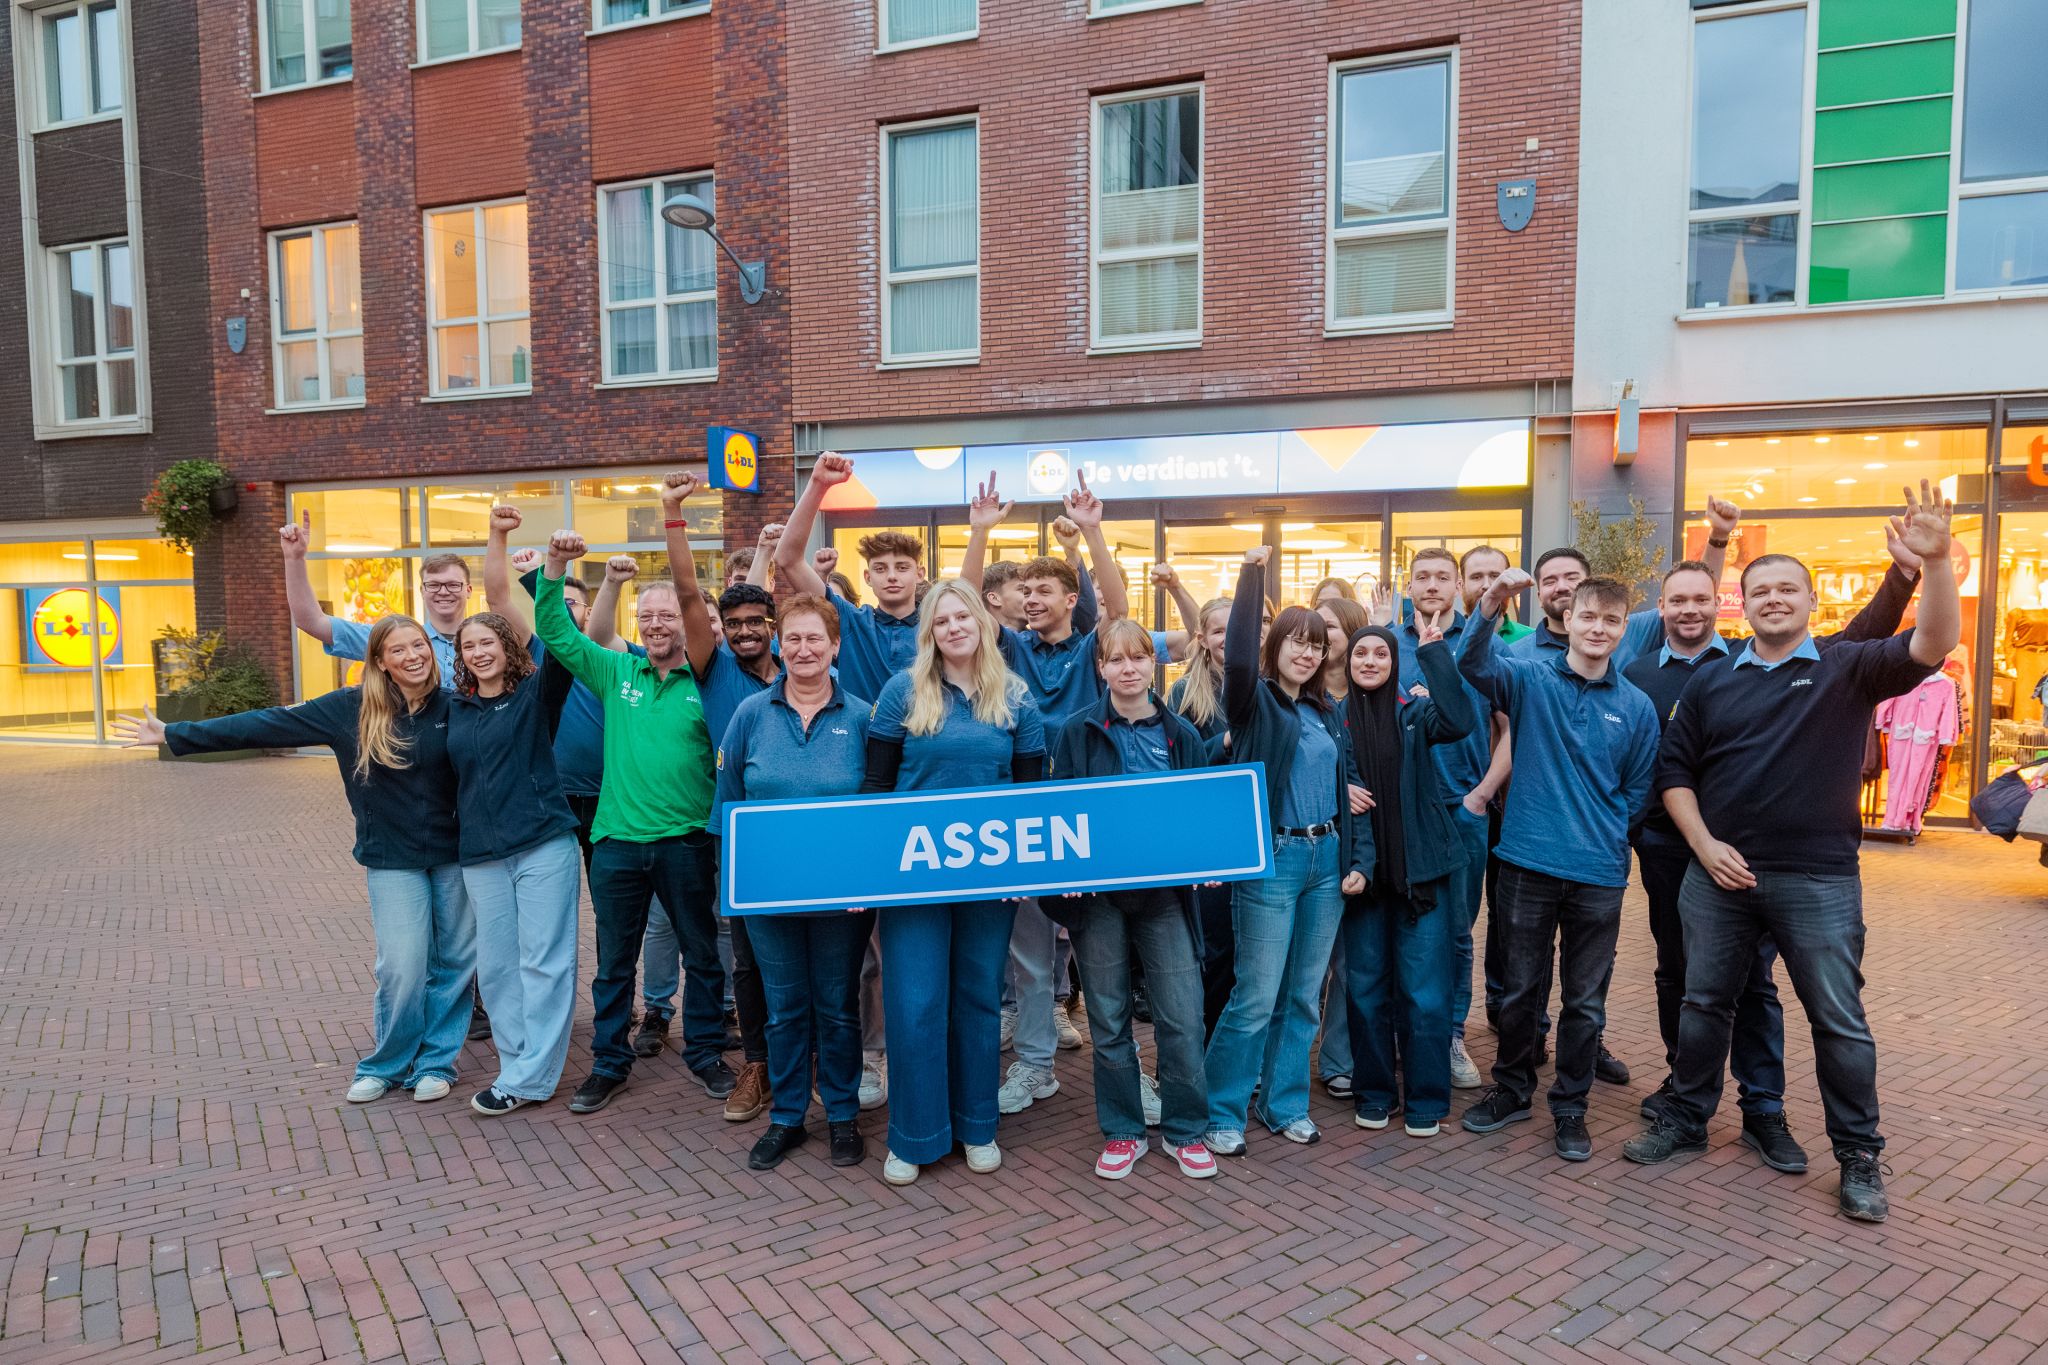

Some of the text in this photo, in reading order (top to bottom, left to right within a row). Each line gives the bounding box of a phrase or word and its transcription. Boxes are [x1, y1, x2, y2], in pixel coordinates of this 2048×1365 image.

[1083, 460, 1112, 484] Je
[1118, 455, 1229, 482] verdient
[899, 813, 1091, 872] ASSEN
